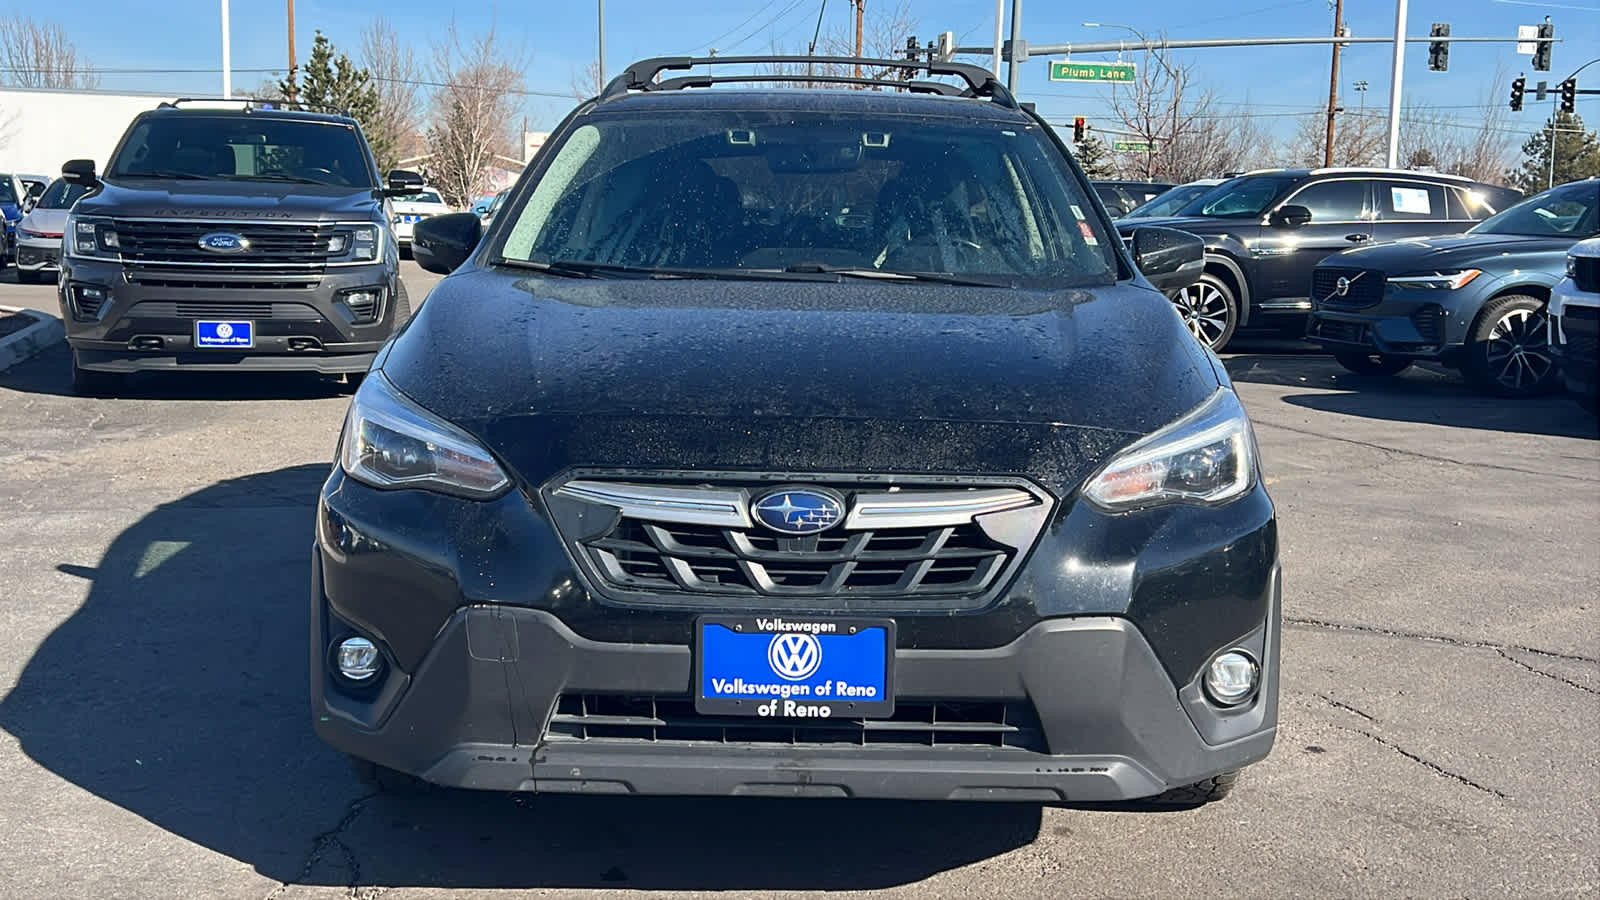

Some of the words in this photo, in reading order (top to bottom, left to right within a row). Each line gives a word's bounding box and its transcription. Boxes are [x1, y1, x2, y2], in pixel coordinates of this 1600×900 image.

[1061, 67, 1095, 76] Plumb
[1100, 69, 1126, 78] Lane
[211, 237, 235, 247] Ford
[756, 618, 836, 634] Volkswagen
[712, 678, 810, 698] Volkswagen
[815, 681, 832, 695] of
[836, 683, 877, 697] Reno
[758, 700, 778, 716] of
[783, 702, 832, 718] Reno
